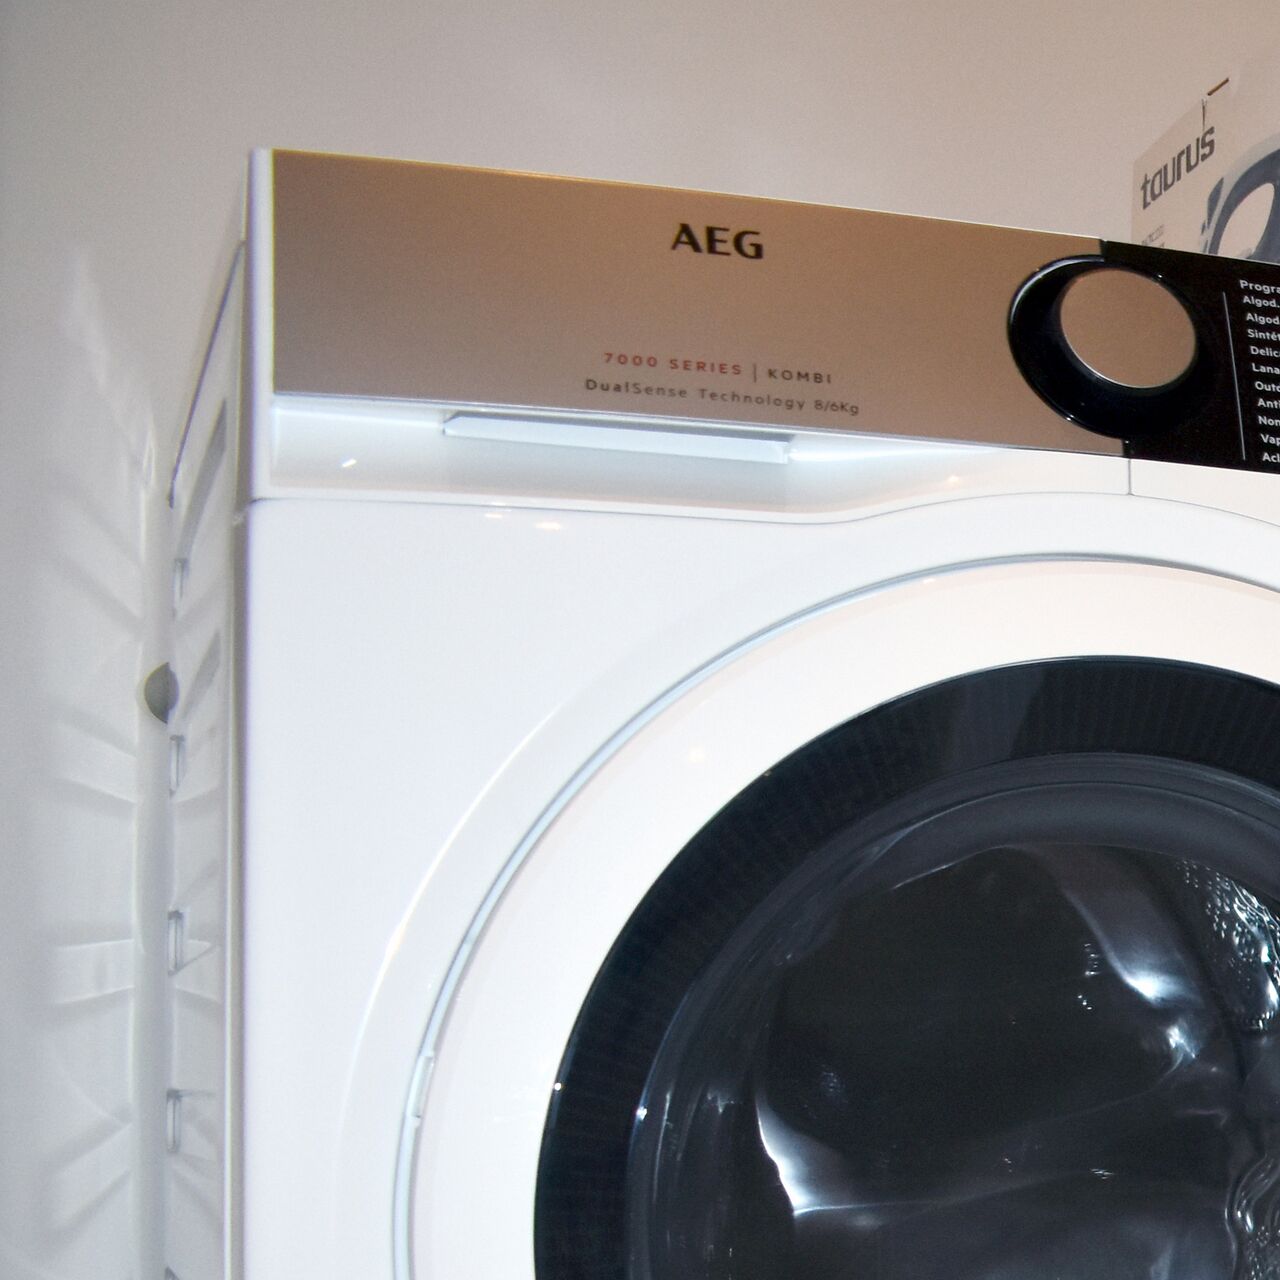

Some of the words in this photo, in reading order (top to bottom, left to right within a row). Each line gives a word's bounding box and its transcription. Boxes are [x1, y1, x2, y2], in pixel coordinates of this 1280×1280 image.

[1140, 126, 1215, 210] taurus
[671, 222, 764, 260] AEG
[1243, 295, 1280, 309] Algod.
[604, 352, 658, 368] 7000
[669, 358, 742, 376] SERIES
[767, 368, 832, 385] KOMBI
[584, 378, 687, 399] DualSense
[699, 387, 805, 410] Technology
